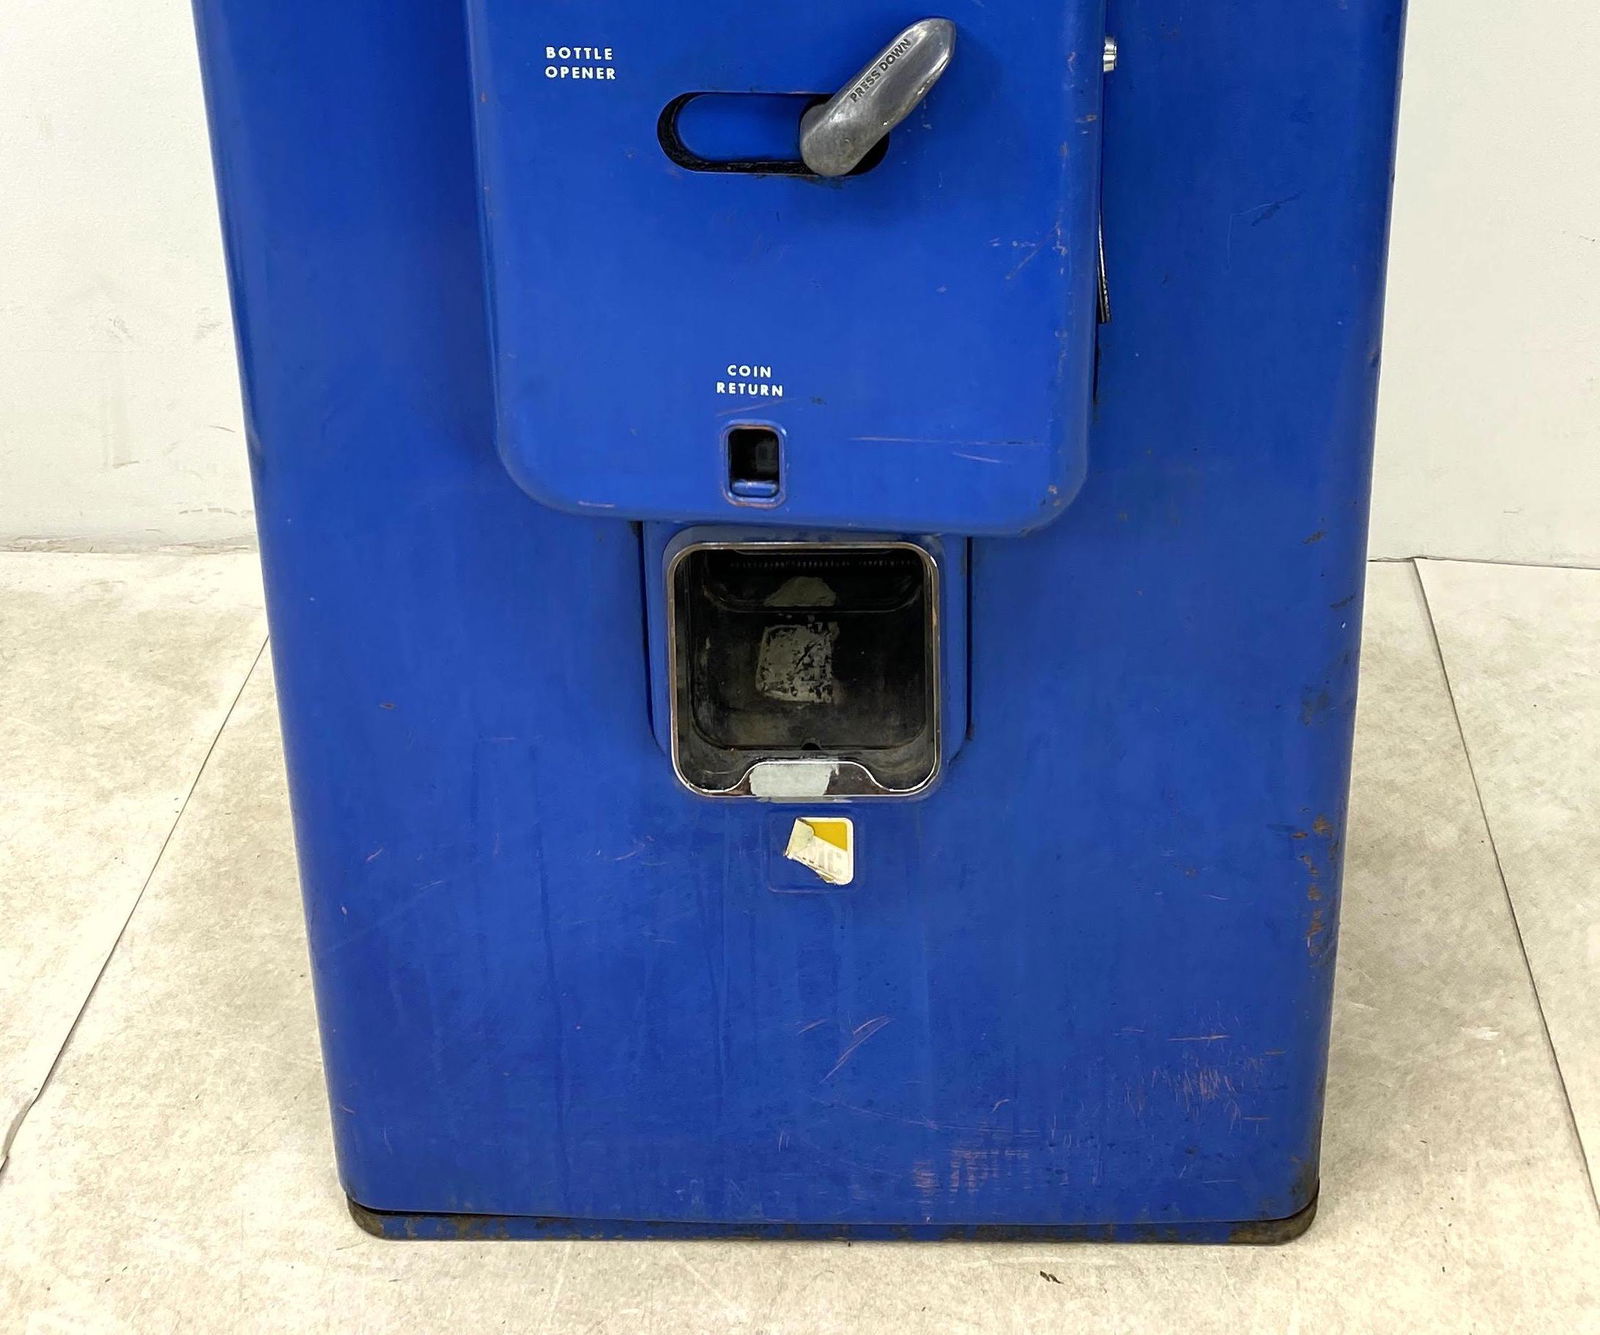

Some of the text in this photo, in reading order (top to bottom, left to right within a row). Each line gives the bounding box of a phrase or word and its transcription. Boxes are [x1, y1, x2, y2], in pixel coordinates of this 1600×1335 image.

[545, 46, 613, 60] BOTTLE
[545, 66, 616, 80] OPENER
[850, 38, 912, 102] PRESS DOWN
[727, 364, 771, 378] COIN
[716, 381, 783, 397] RETURN
